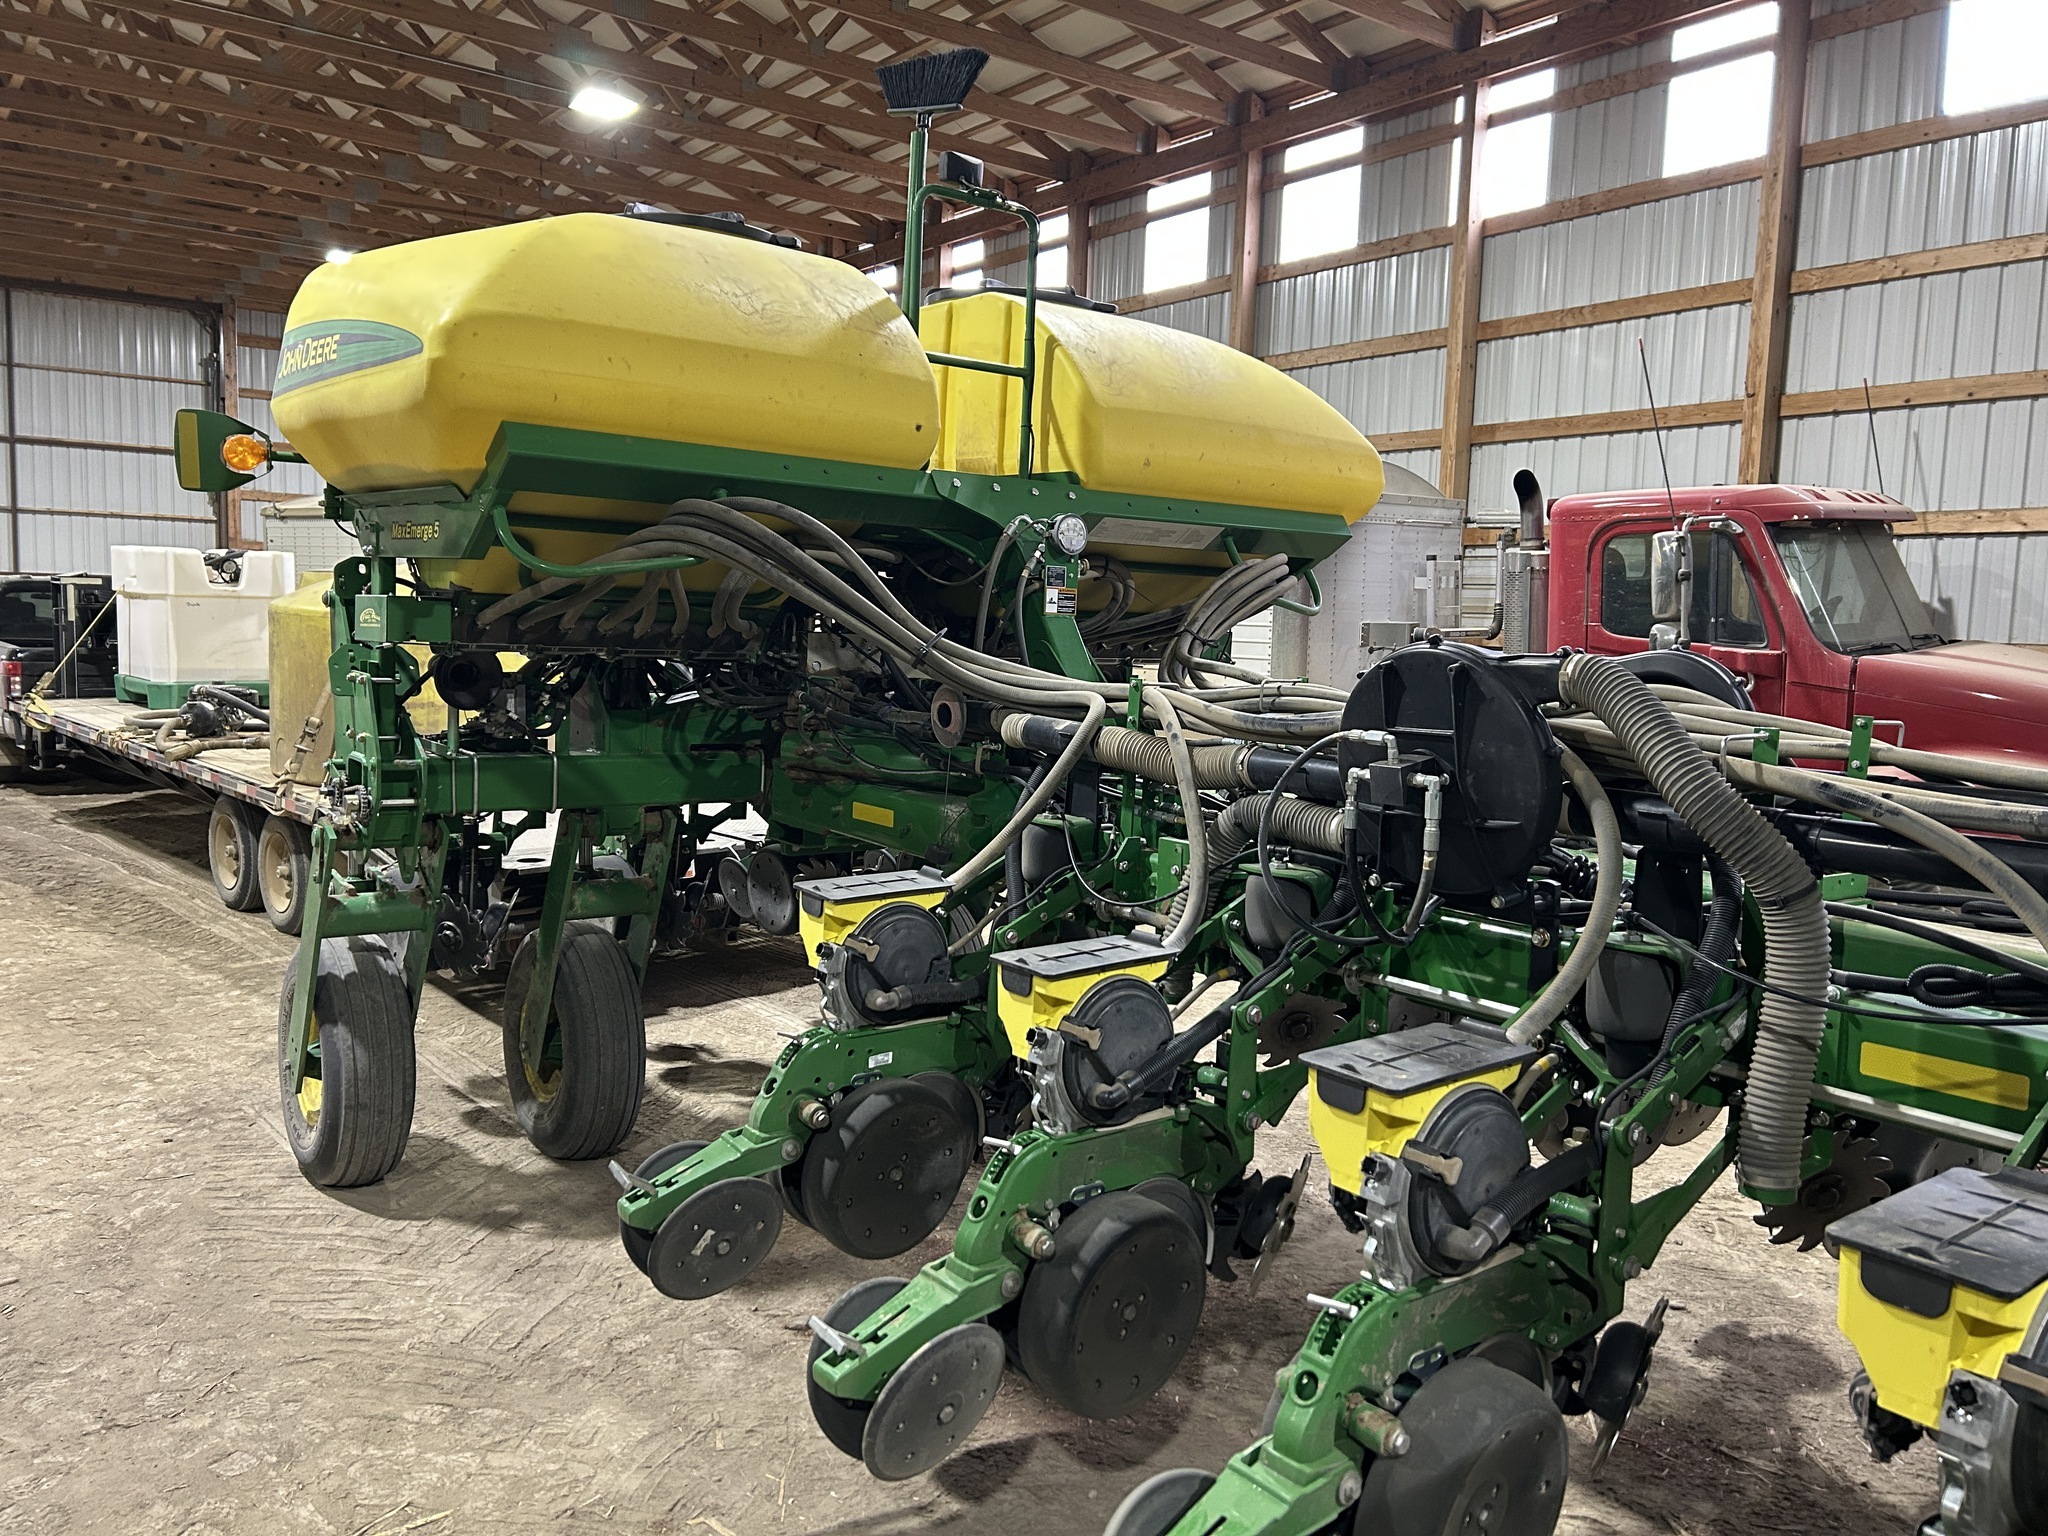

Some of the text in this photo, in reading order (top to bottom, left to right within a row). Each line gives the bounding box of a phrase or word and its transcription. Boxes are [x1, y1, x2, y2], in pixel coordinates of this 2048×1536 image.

[278, 333, 341, 379] JOHN DEERE
[391, 520, 440, 542] MaxEmerge 5
